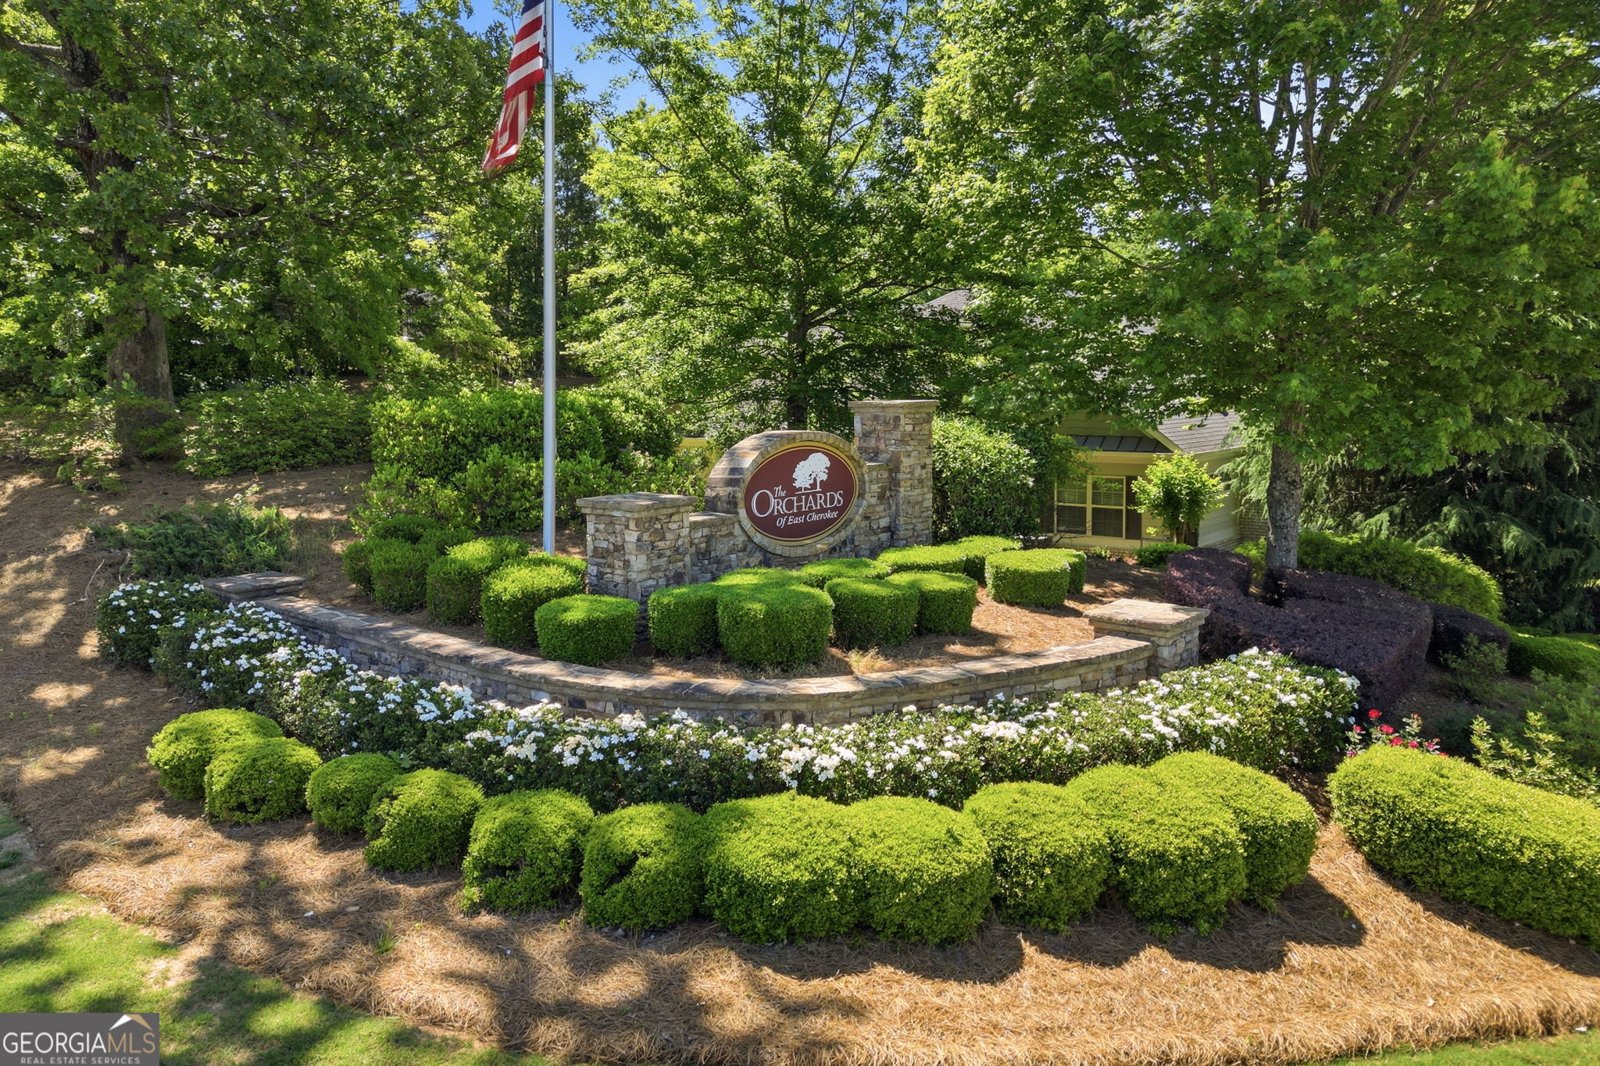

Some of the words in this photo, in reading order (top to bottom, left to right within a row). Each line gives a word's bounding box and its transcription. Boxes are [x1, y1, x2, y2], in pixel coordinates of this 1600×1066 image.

[773, 485, 787, 498] The
[751, 489, 844, 518] ORCHARDS
[788, 516, 805, 525] East
[806, 510, 839, 522] Cherokee
